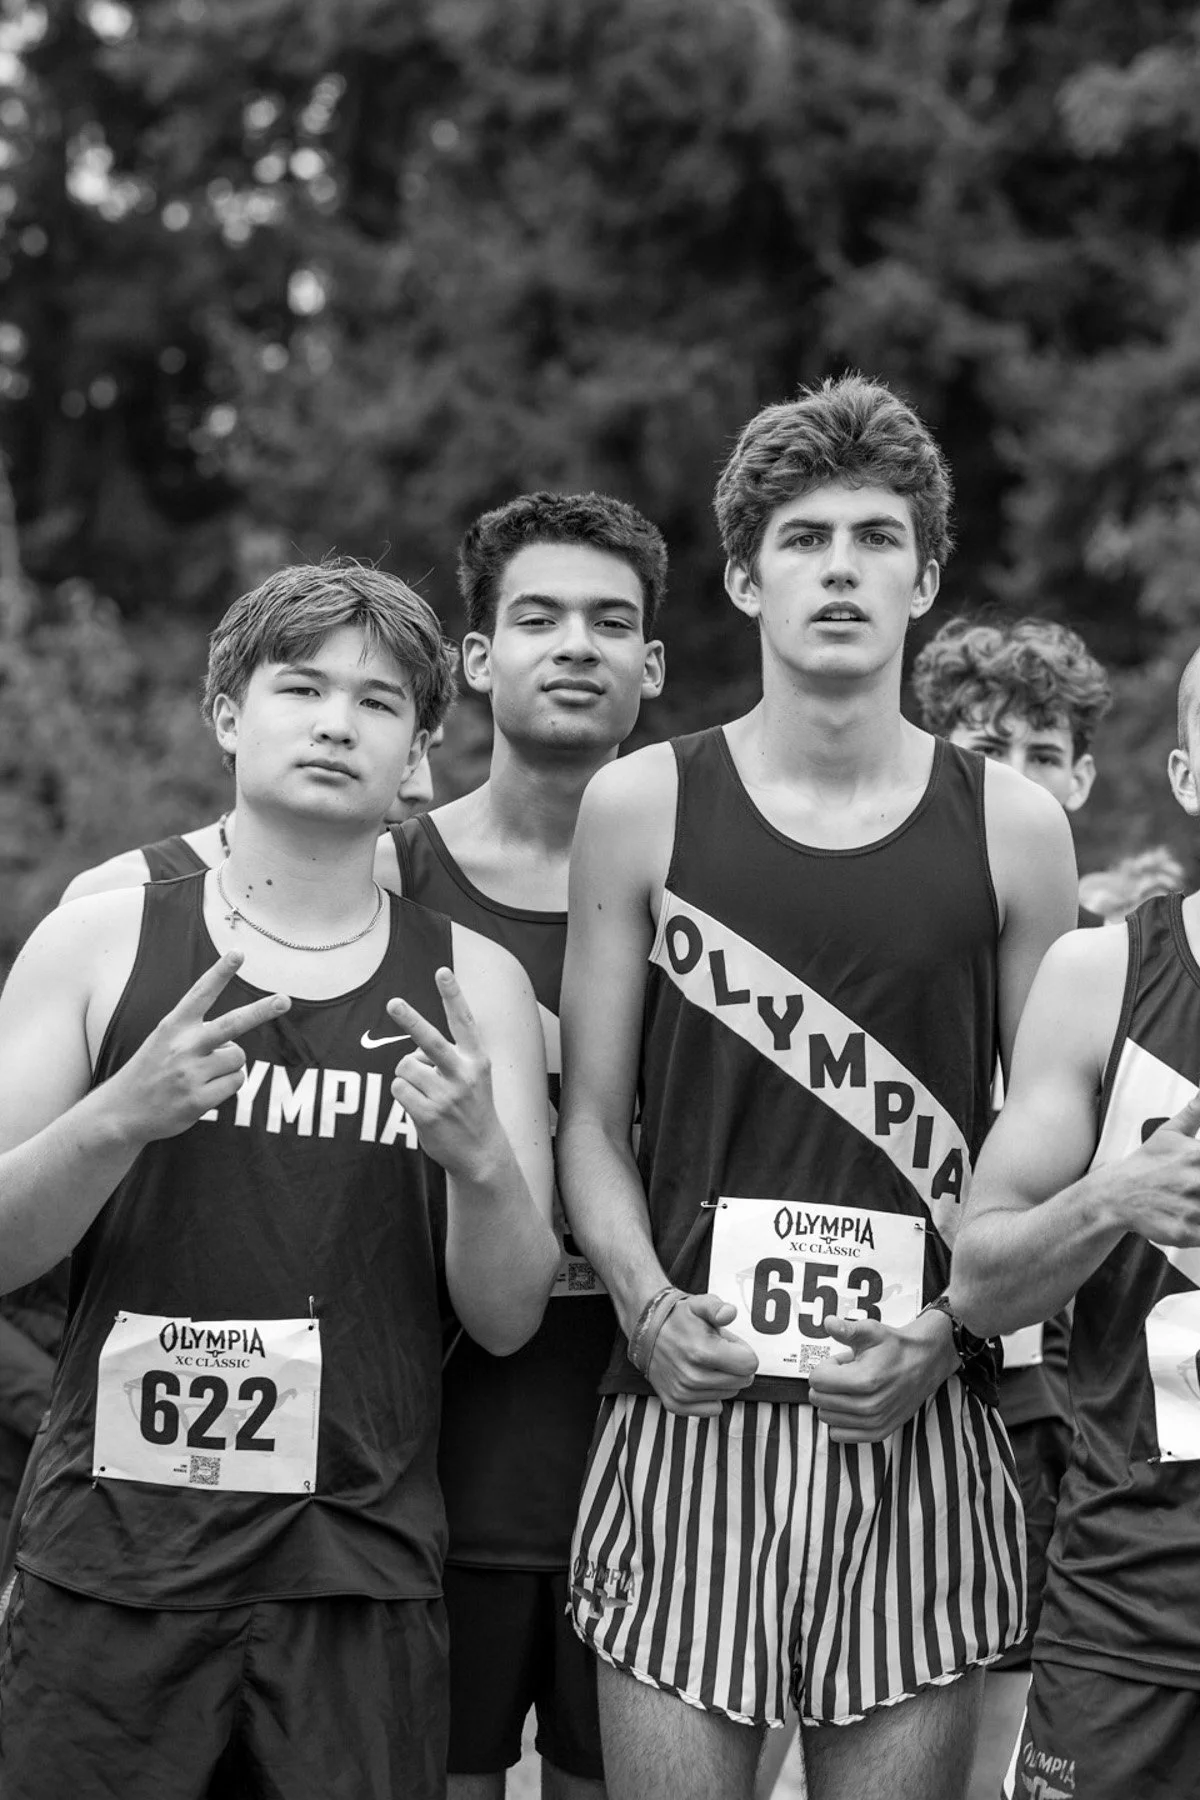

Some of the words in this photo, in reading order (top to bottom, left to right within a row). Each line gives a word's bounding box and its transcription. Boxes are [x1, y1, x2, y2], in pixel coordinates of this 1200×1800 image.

[665, 914, 963, 1204] OLYMPIA
[199, 1060, 418, 1150] YMPIA
[774, 1206, 875, 1250] OLYMPIA
[789, 1241, 808, 1252] XC
[809, 1243, 861, 1258] CLASSIC
[751, 1257, 884, 1340] 653
[159, 1322, 266, 1359] OLYMPIA
[175, 1355, 194, 1367] XC
[195, 1356, 251, 1369] CLASSIC
[139, 1370, 278, 1452] 622
